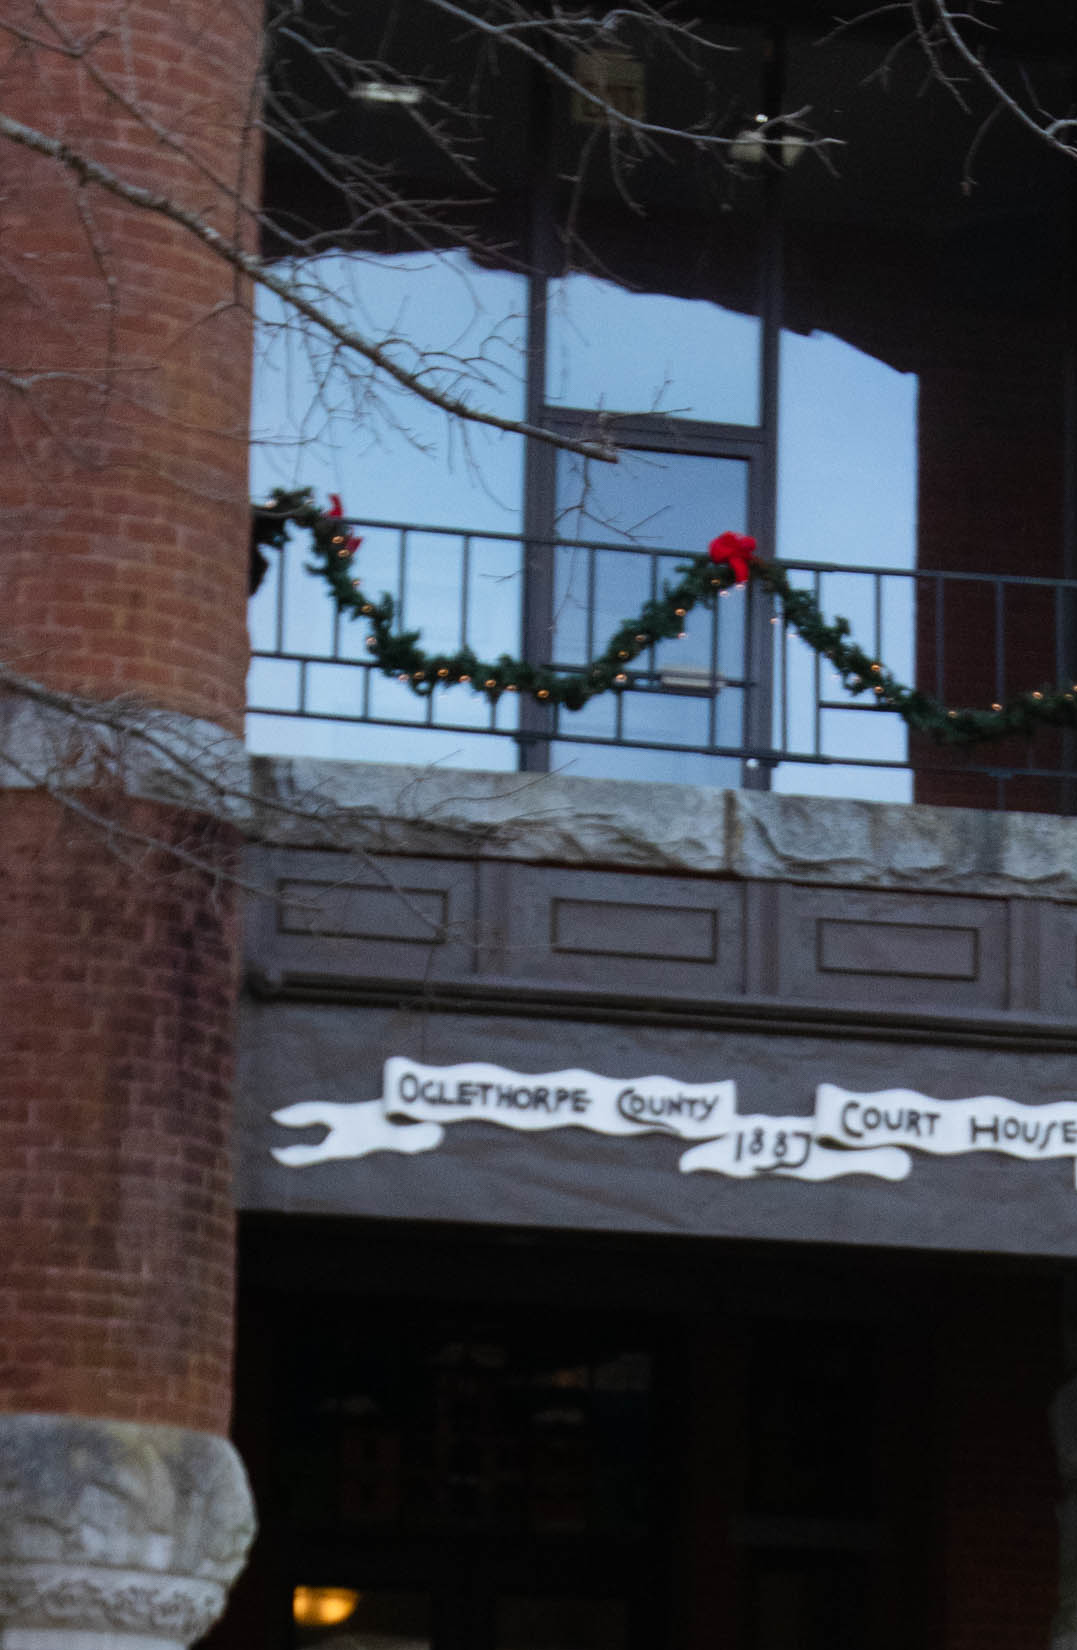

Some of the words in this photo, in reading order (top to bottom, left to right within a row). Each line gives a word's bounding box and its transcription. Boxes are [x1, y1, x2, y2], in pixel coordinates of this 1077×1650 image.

[399, 1074, 592, 1114] OGLETHORPE
[617, 1088, 721, 1135] COUNTY
[841, 1101, 941, 1138] COURT
[735, 1127, 812, 1172] 1887
